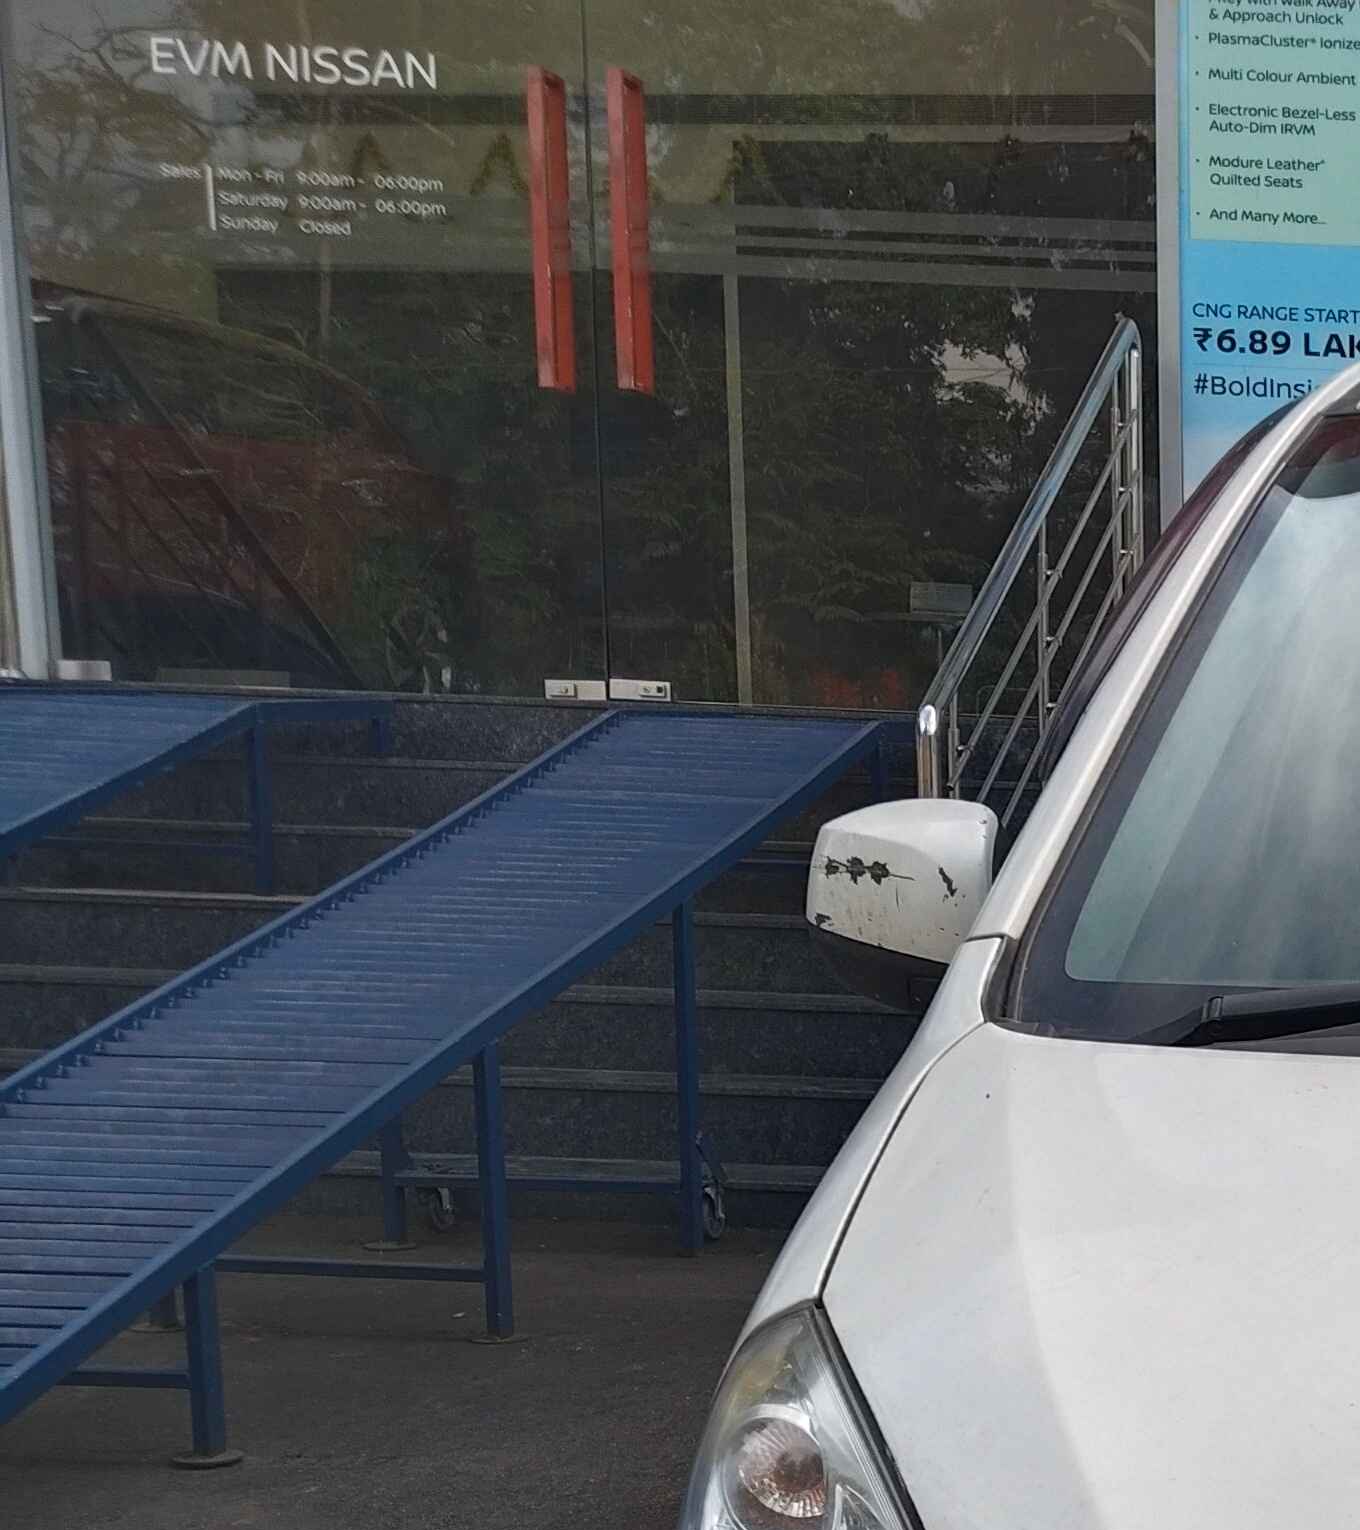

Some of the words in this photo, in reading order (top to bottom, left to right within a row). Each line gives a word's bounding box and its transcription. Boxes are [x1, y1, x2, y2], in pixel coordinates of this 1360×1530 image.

[1208, 8, 1218, 20] &
[1222, 9, 1291, 24] Approach
[1295, 12, 1344, 26] Unlock
[150, 36, 254, 80] EVM
[264, 41, 438, 90] NISSAN
[1208, 68, 1243, 81] Multi
[1246, 69, 1293, 83] Colour
[1296, 71, 1356, 86] Ambient
[1208, 103, 1278, 118] Electronic
[1281, 106, 1357, 121] Bezel-Less
[1208, 120, 1277, 134] Auto-Dim
[1280, 123, 1316, 137] IRVM
[159, 162, 201, 179] Sales
[1208, 155, 1264, 169] Modure
[217, 166, 252, 183] Mon
[263, 167, 285, 184] Fri
[1209, 172, 1261, 187] Quilted
[1264, 175, 1304, 189] Seats
[216, 190, 289, 211] Saturday
[217, 213, 280, 234] Sunday
[299, 218, 352, 236] Closed
[1209, 208, 1238, 221] And
[1241, 209, 1280, 226] Many
[1192, 302, 1232, 319] CNG
[1237, 304, 1299, 322] RANGE
[1193, 327, 1291, 356] ₹6.89
[1194, 372, 1321, 400] #BoldInsi
